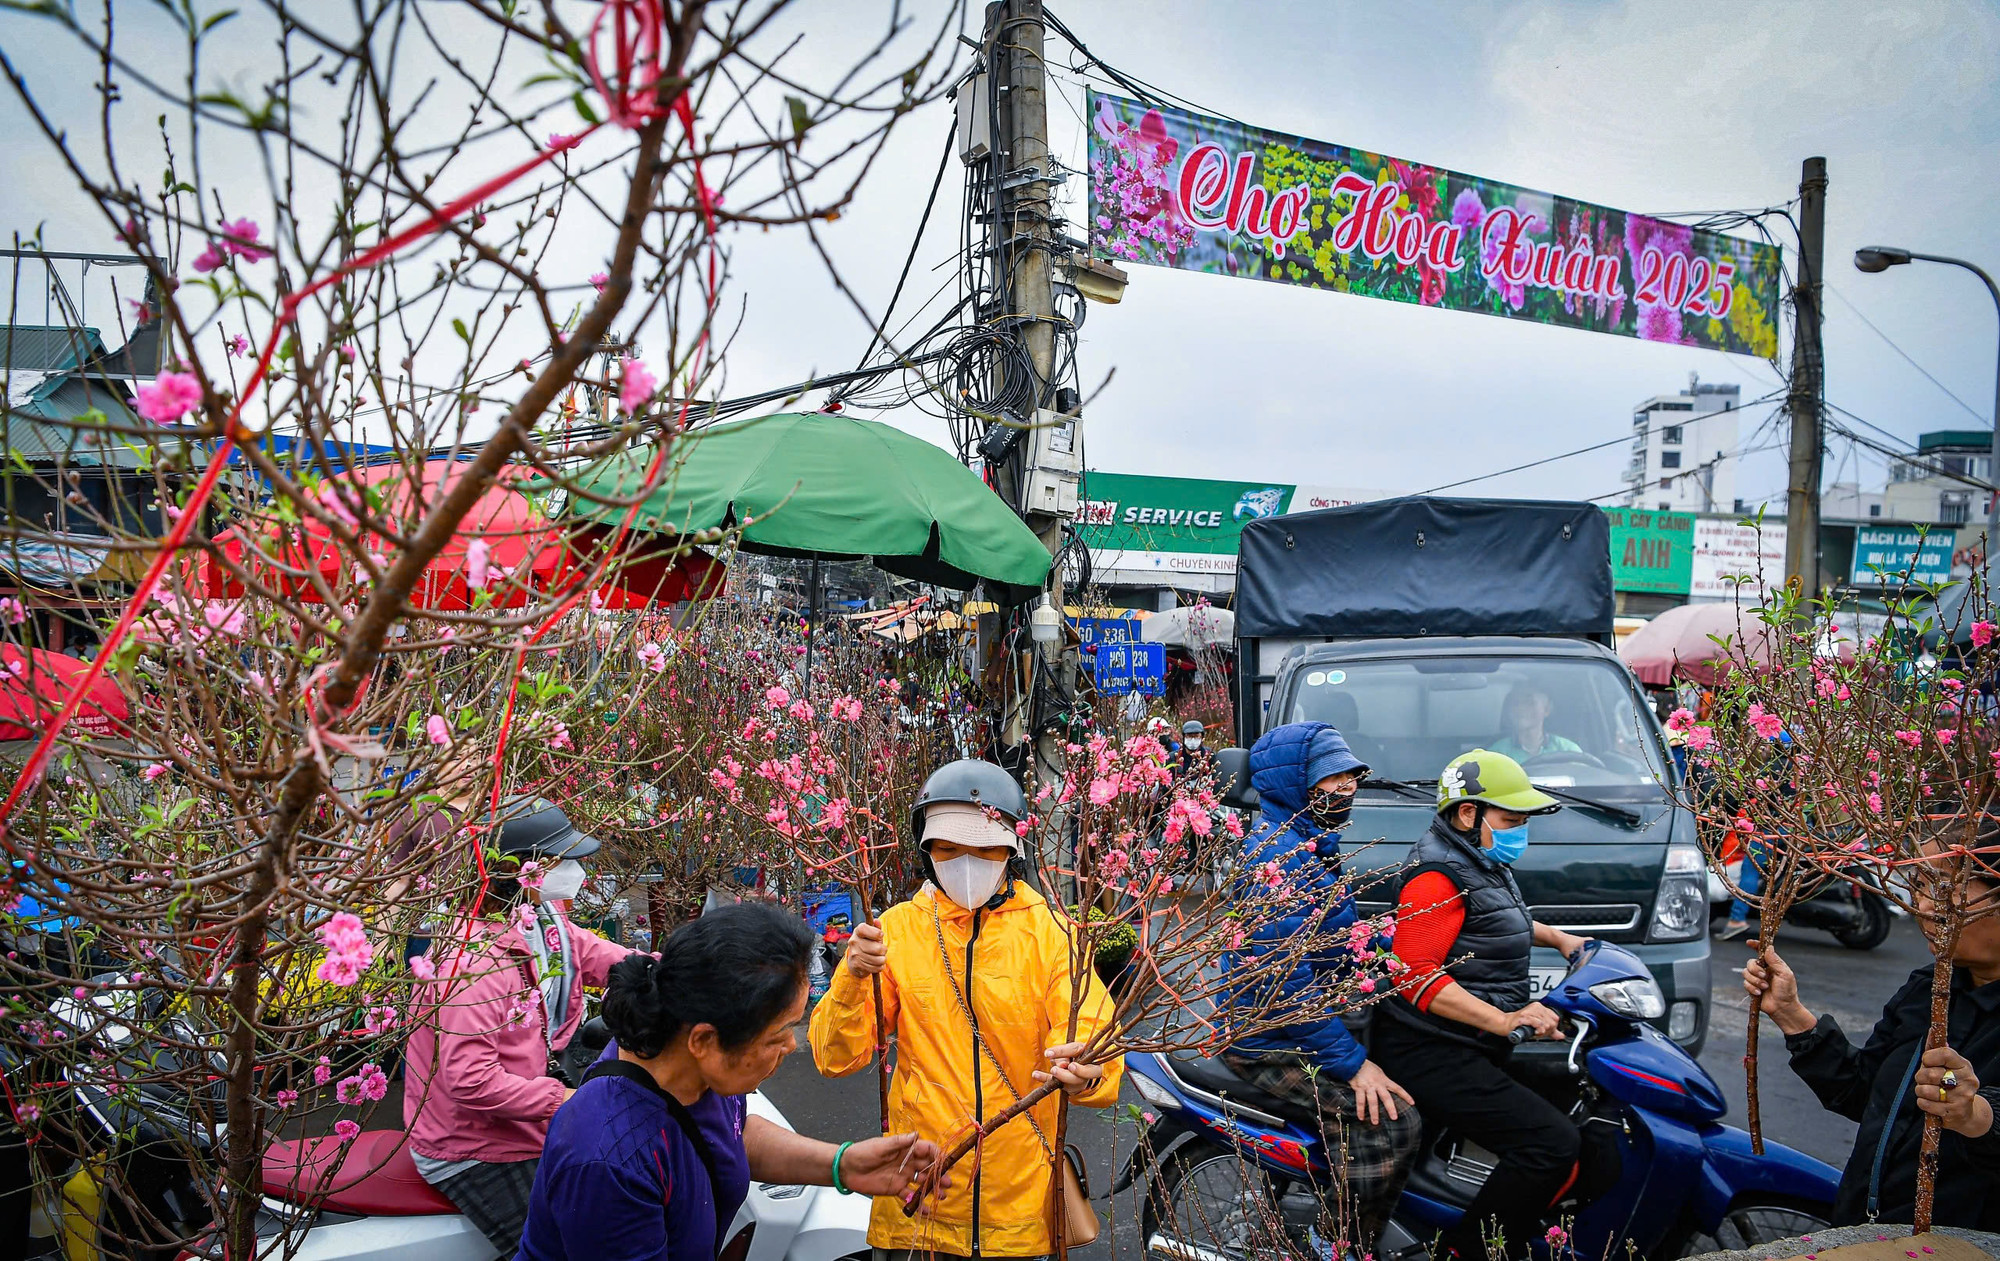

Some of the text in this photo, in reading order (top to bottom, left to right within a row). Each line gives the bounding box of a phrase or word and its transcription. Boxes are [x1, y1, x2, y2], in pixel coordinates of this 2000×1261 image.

[1178, 141, 1736, 319] Chợ Hoa Xuân 2025
[1123, 507, 1223, 527] SERVICE
[1170, 557, 1212, 569] CHUYÊN
[1132, 650, 1149, 667] 238
